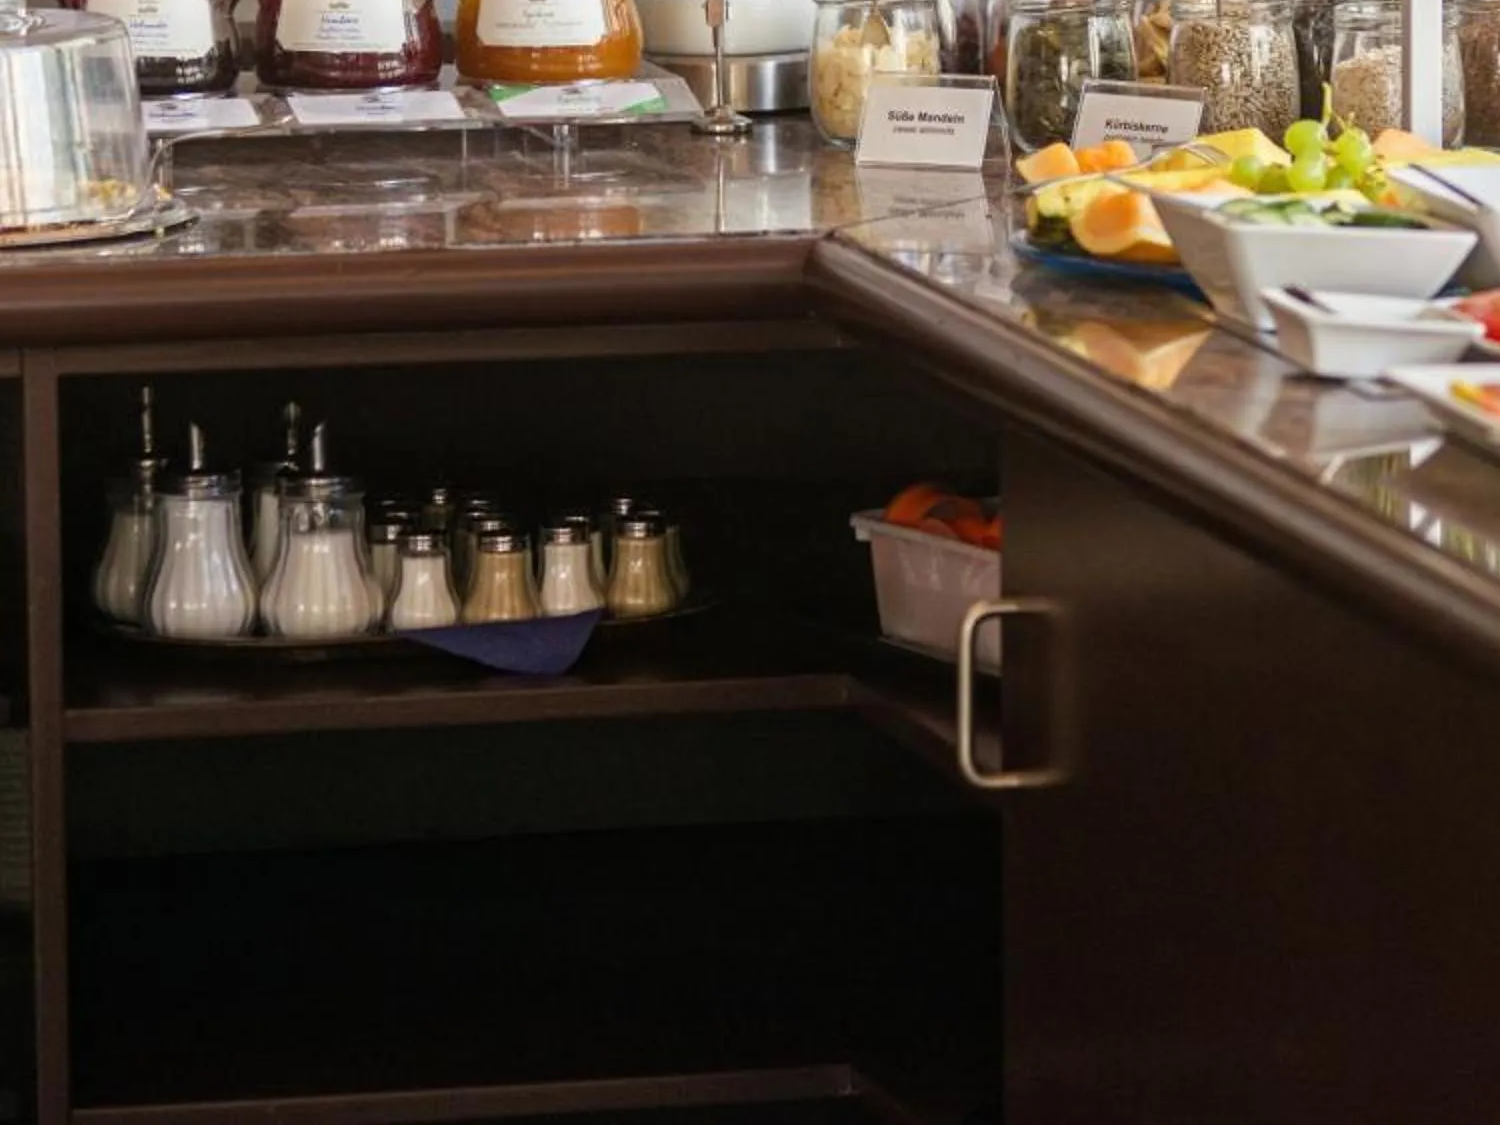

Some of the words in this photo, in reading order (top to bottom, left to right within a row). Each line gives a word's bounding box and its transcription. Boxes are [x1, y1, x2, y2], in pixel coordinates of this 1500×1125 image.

[887, 109, 915, 122] Süße
[917, 110, 966, 125] Mandeln
[1104, 118, 1170, 134] Kürbiskerne
